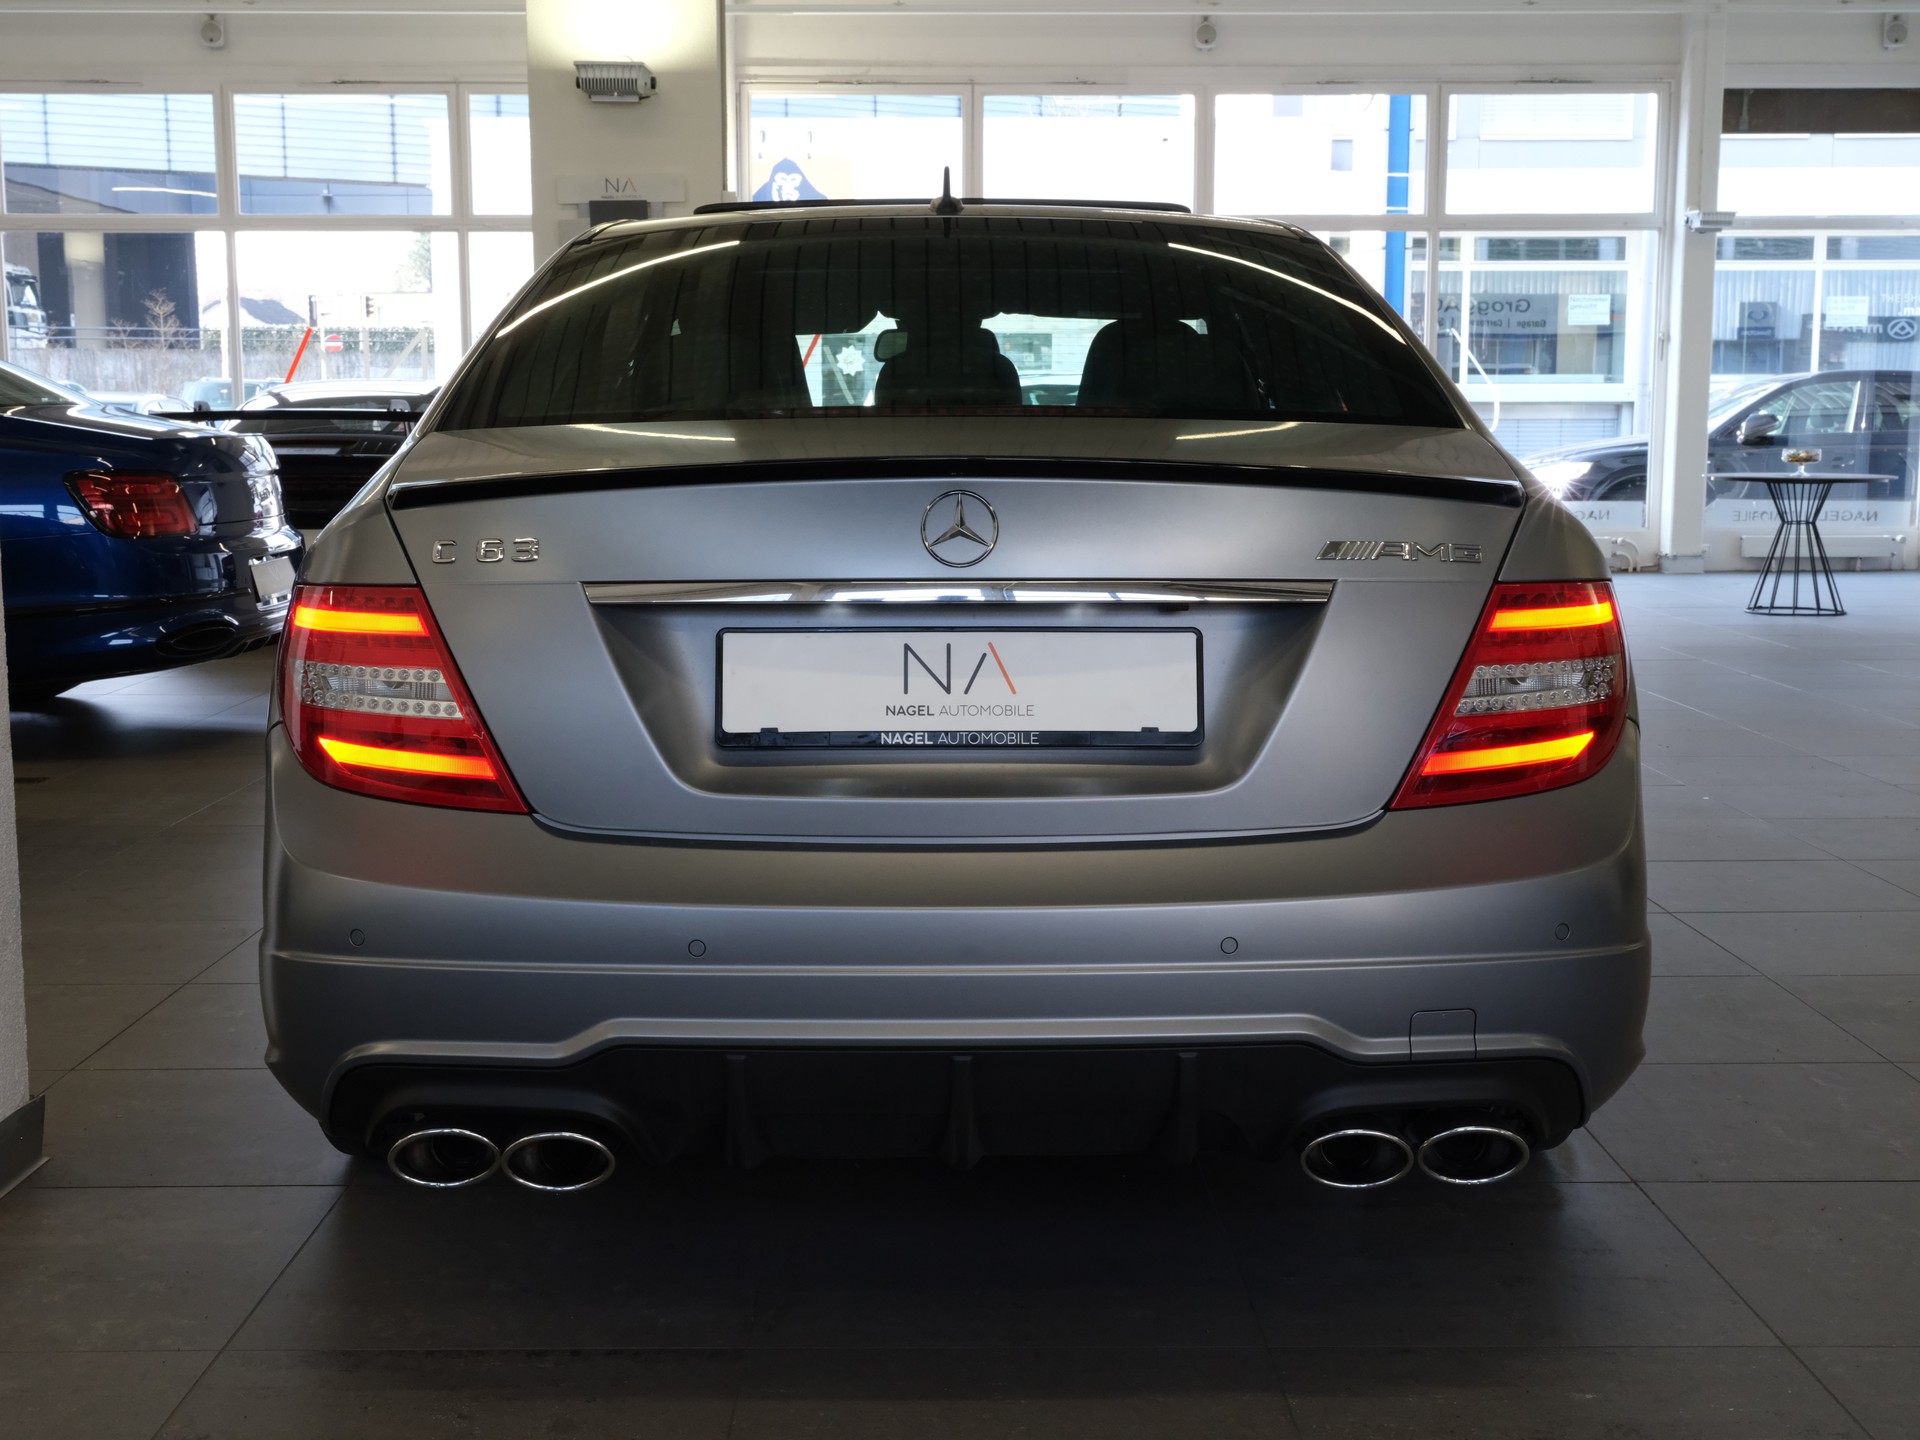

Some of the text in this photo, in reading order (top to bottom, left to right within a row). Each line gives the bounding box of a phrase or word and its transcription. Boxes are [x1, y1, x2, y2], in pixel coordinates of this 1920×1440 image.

[1903, 293, 1920, 303] SH
[432, 537, 540, 564] C 63
[1371, 541, 1483, 563] AMG
[904, 642, 1017, 695] NA
[885, 704, 1035, 717] NAGEL AUTOMOBILE
[880, 731, 1040, 745] NAGEL AUTOMOBILE
